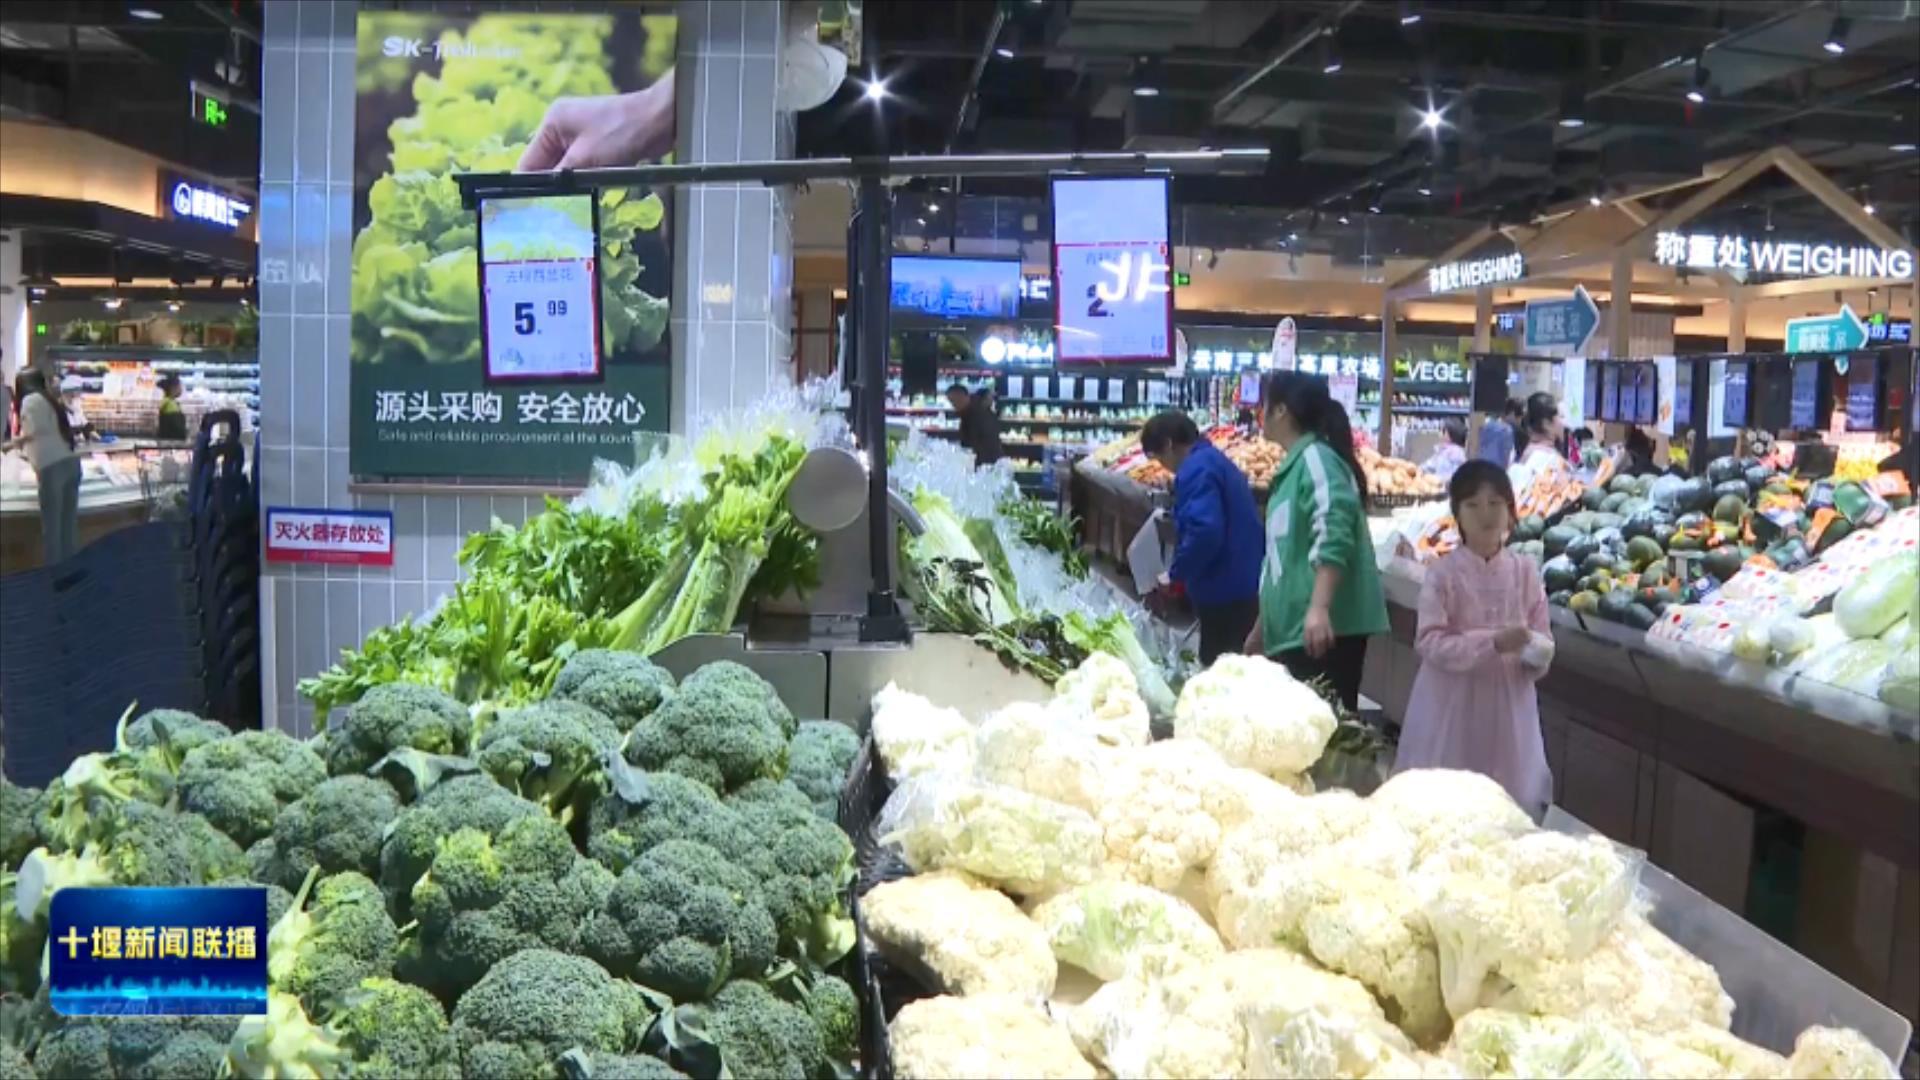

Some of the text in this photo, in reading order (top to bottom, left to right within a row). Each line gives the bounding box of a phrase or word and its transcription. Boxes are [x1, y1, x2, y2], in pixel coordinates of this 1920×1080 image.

[1460, 252, 1522, 287] WEIGHING
[1656, 232, 1912, 278] 称重处 WEIGHING
[375, 390, 646, 425] 源头采购 安全放心
[408, 430, 433, 442] and
[481, 431, 560, 445] procurement
[576, 431, 597, 444] the
[275, 521, 384, 545] 灭火器存放处
